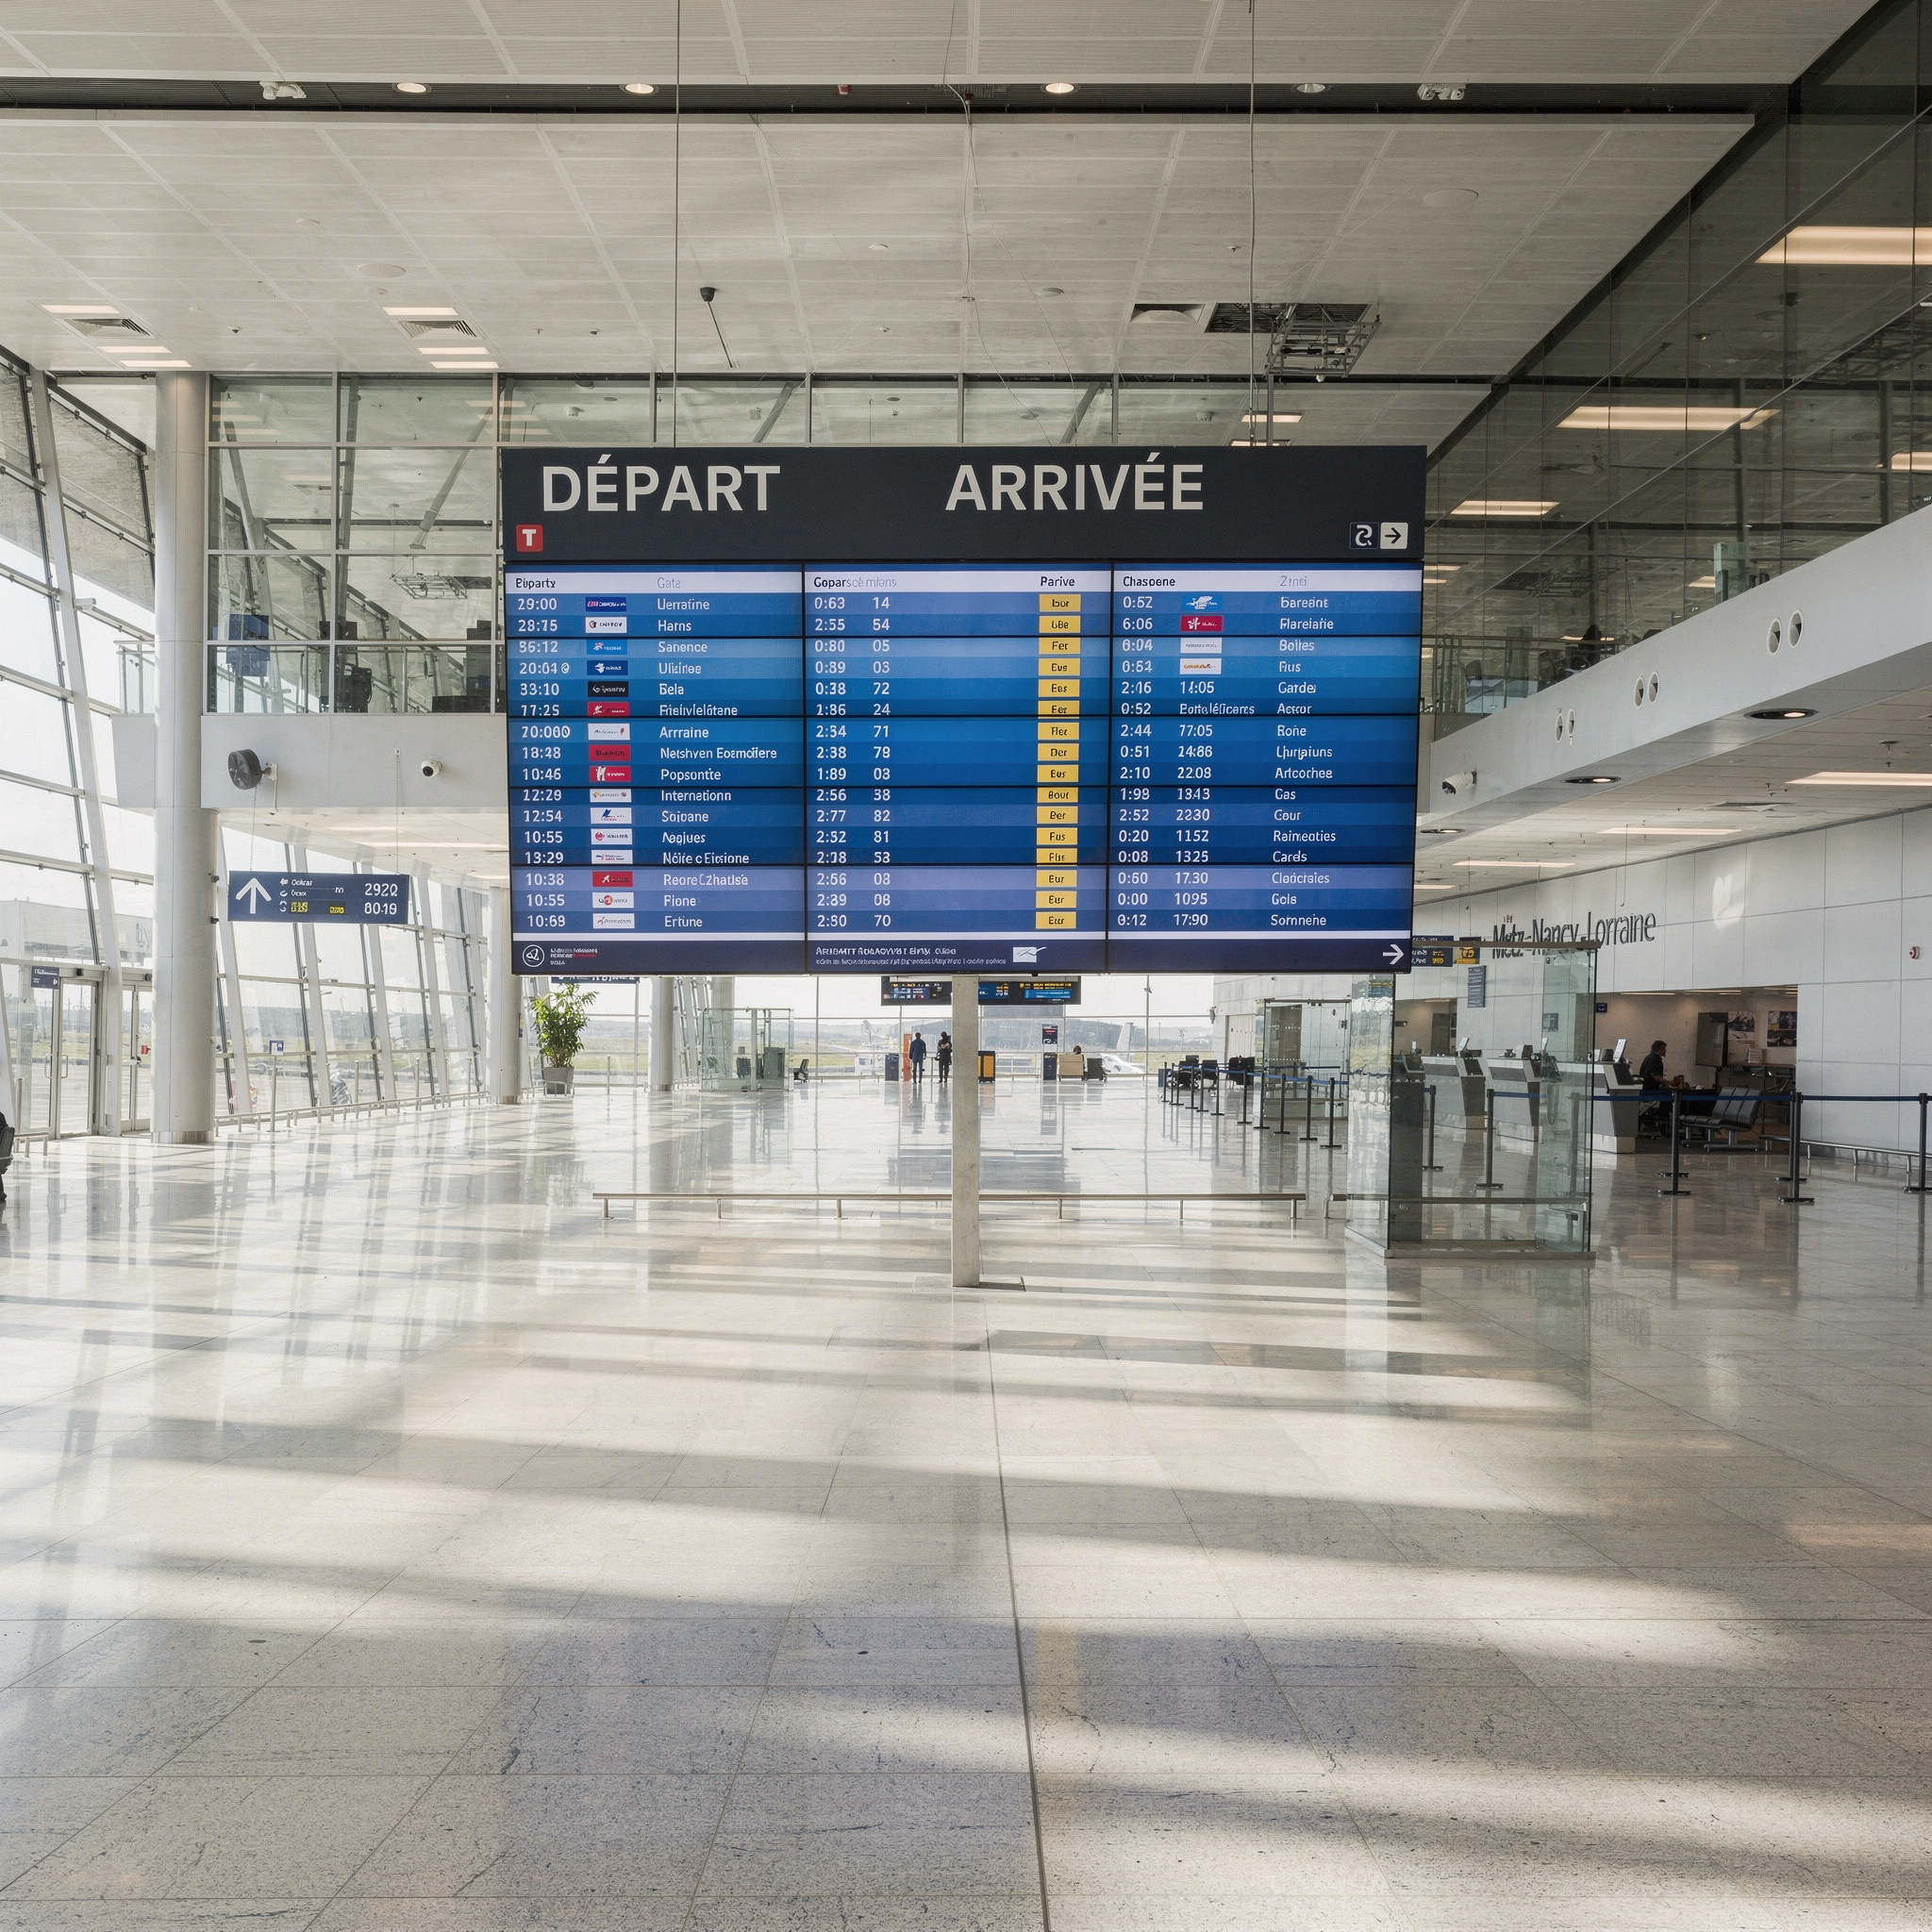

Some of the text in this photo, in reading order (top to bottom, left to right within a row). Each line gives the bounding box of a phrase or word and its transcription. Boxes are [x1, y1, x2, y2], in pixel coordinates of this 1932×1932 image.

[543, 454, 781, 512] DÉPART
[945, 452, 1203, 510] ARRIVÉE
[522, 528, 537, 546] T
[873, 596, 891, 609] 14
[873, 681, 891, 695] 72
[873, 703, 891, 716] 24
[873, 724, 889, 739] 71
[1120, 724, 1153, 738] 2:44
[1120, 744, 1150, 758] 0:51
[1120, 766, 1151, 779] 2:10
[523, 809, 563, 823] 12:54
[816, 809, 846, 823] 2:77
[874, 808, 891, 823] 82
[1119, 808, 1150, 822] 2:52
[524, 830, 563, 844] 10:55
[873, 830, 890, 843] 81
[1118, 829, 1149, 842] 0:20
[1118, 849, 1149, 863] 0:08
[525, 873, 565, 886] 10:38
[526, 893, 565, 907] 10:55
[1117, 892, 1148, 906] 0:00
[874, 914, 891, 927] 70
